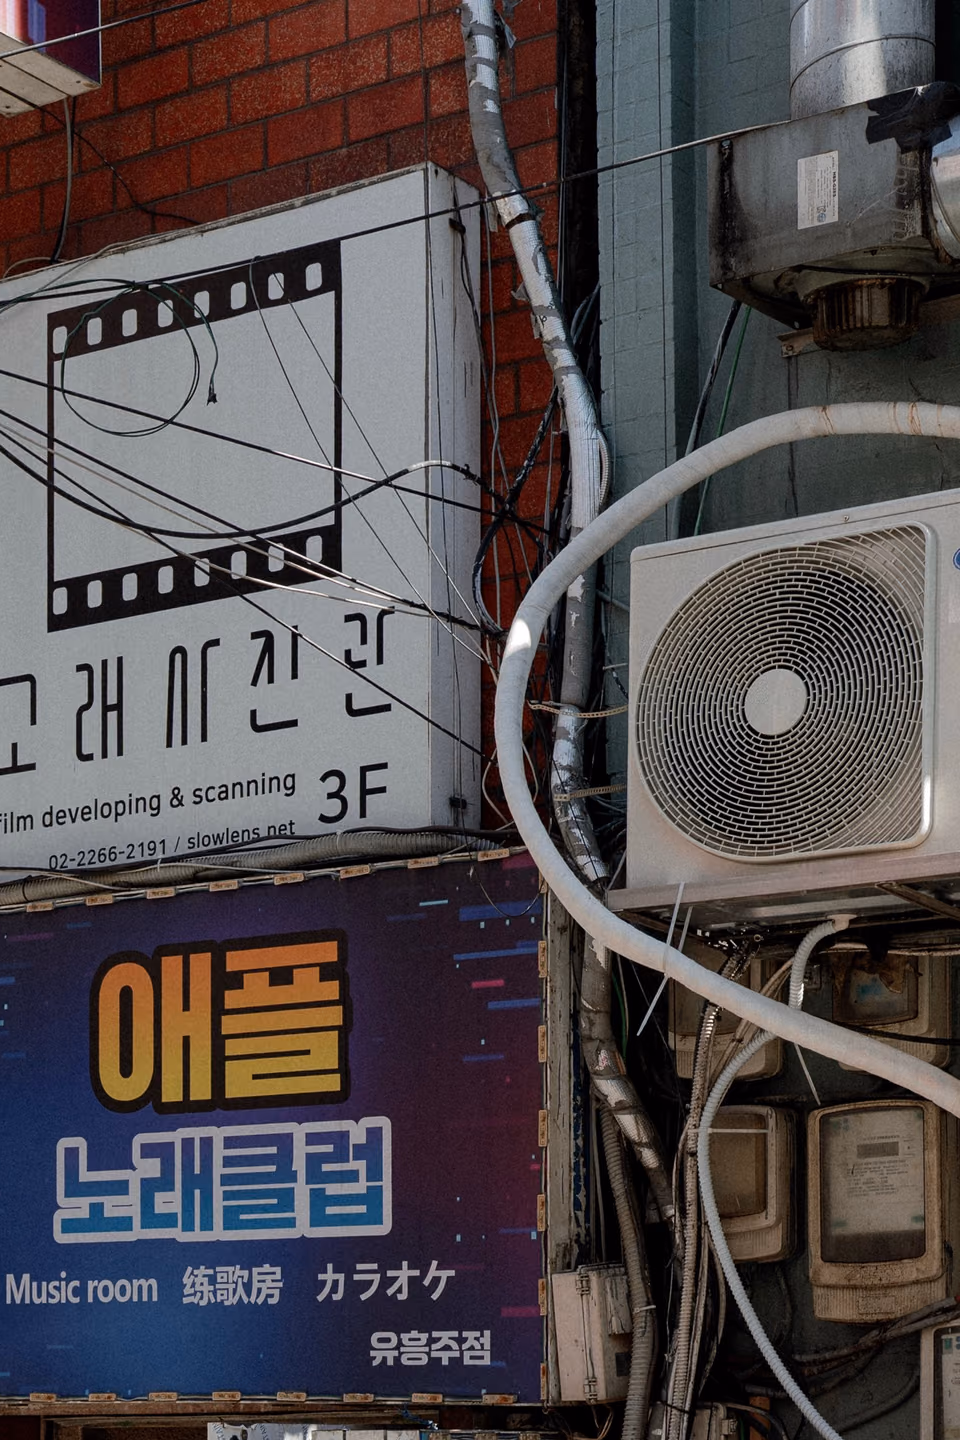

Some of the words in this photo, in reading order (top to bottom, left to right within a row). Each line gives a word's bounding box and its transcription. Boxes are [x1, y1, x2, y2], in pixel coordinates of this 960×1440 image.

[41, 792, 161, 829] developing
[169, 786, 185, 808] &
[192, 771, 297, 806] scanning
[318, 762, 388, 824] 3F
[49, 839, 166, 871] 02-2266-2191
[97, 939, 344, 1104] 애플
[53, 1116, 393, 1243] 노래클럽
[5, 1270, 82, 1304] Music
[88, 1276, 158, 1303] room
[182, 1264, 283, 1305] 练歌房
[316, 1259, 456, 1301] カラオケ
[369, 1330, 493, 1366] 유흥주점
